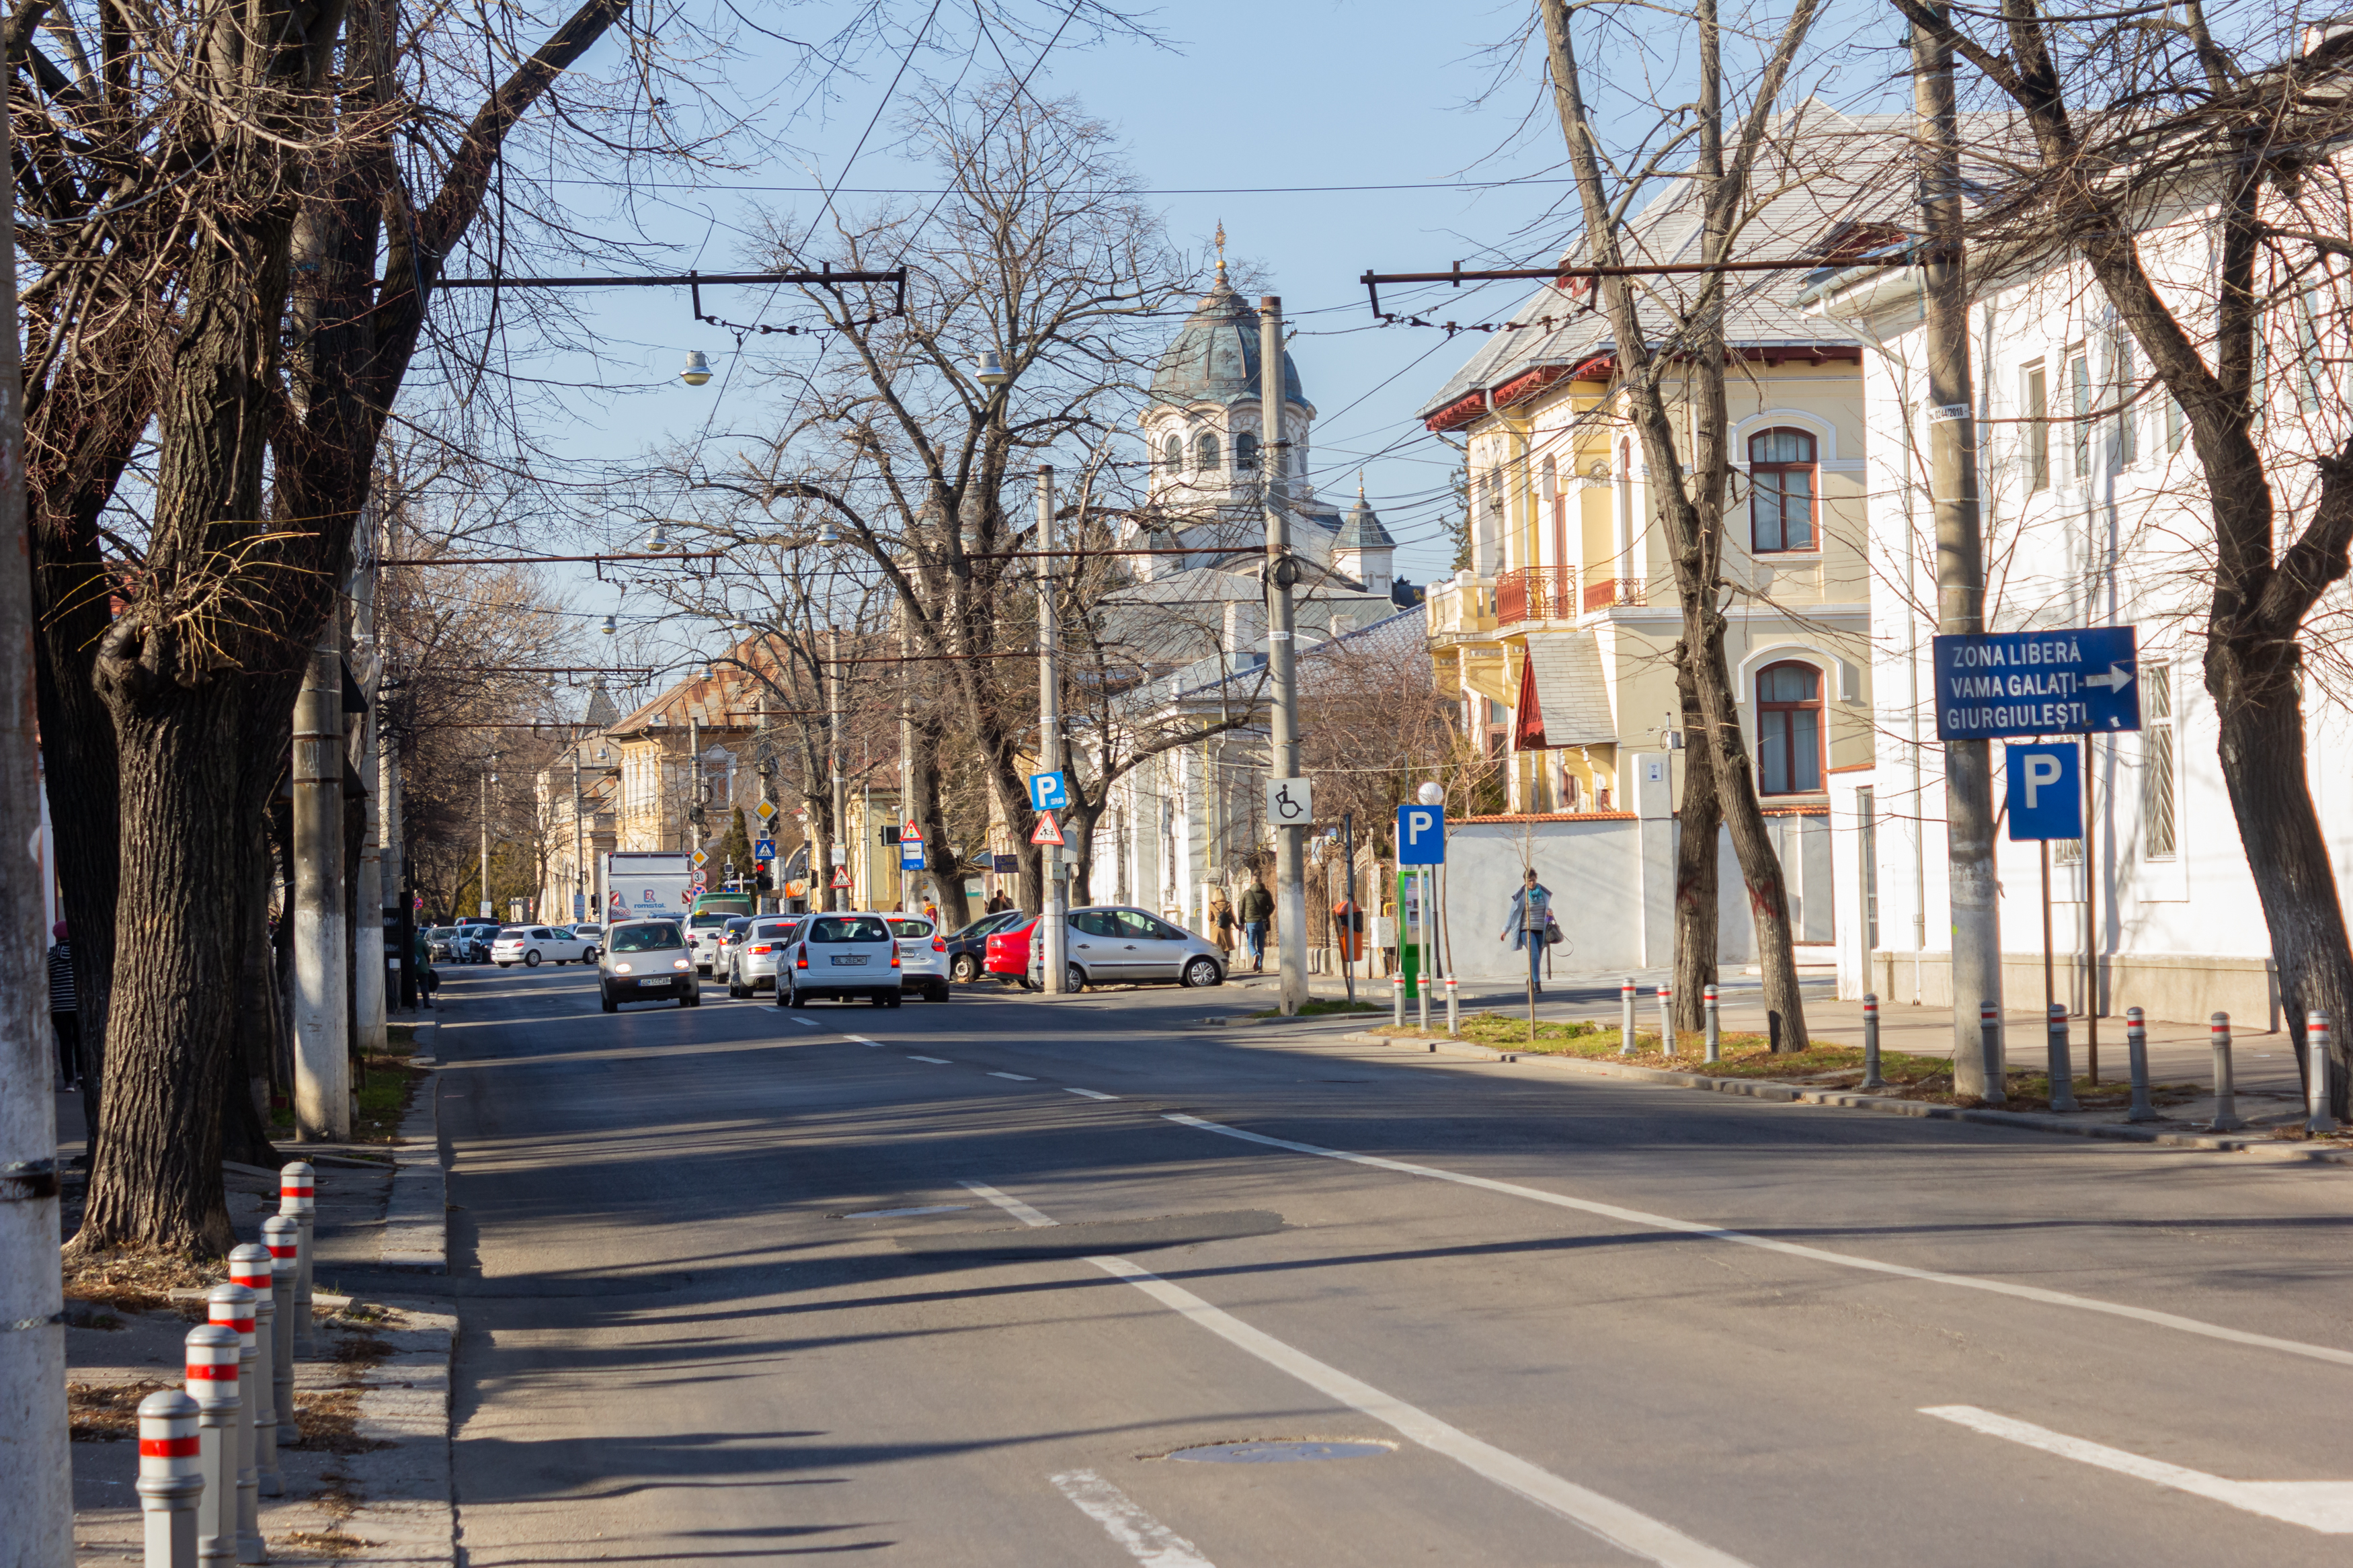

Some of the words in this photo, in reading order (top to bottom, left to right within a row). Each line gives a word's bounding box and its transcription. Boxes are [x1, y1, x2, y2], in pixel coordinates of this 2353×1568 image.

[1936, 407, 1963, 419] 0244/2018
[1953, 645, 2005, 668] ZONA
[2009, 636, 2082, 665] LIBERĂ
[1951, 675, 2004, 698] VAMA
[1947, 702, 2087, 731] GIURGIULEȘTI
[1037, 776, 1057, 807] P
[2024, 753, 2063, 809] P
[1408, 811, 1433, 845] P
